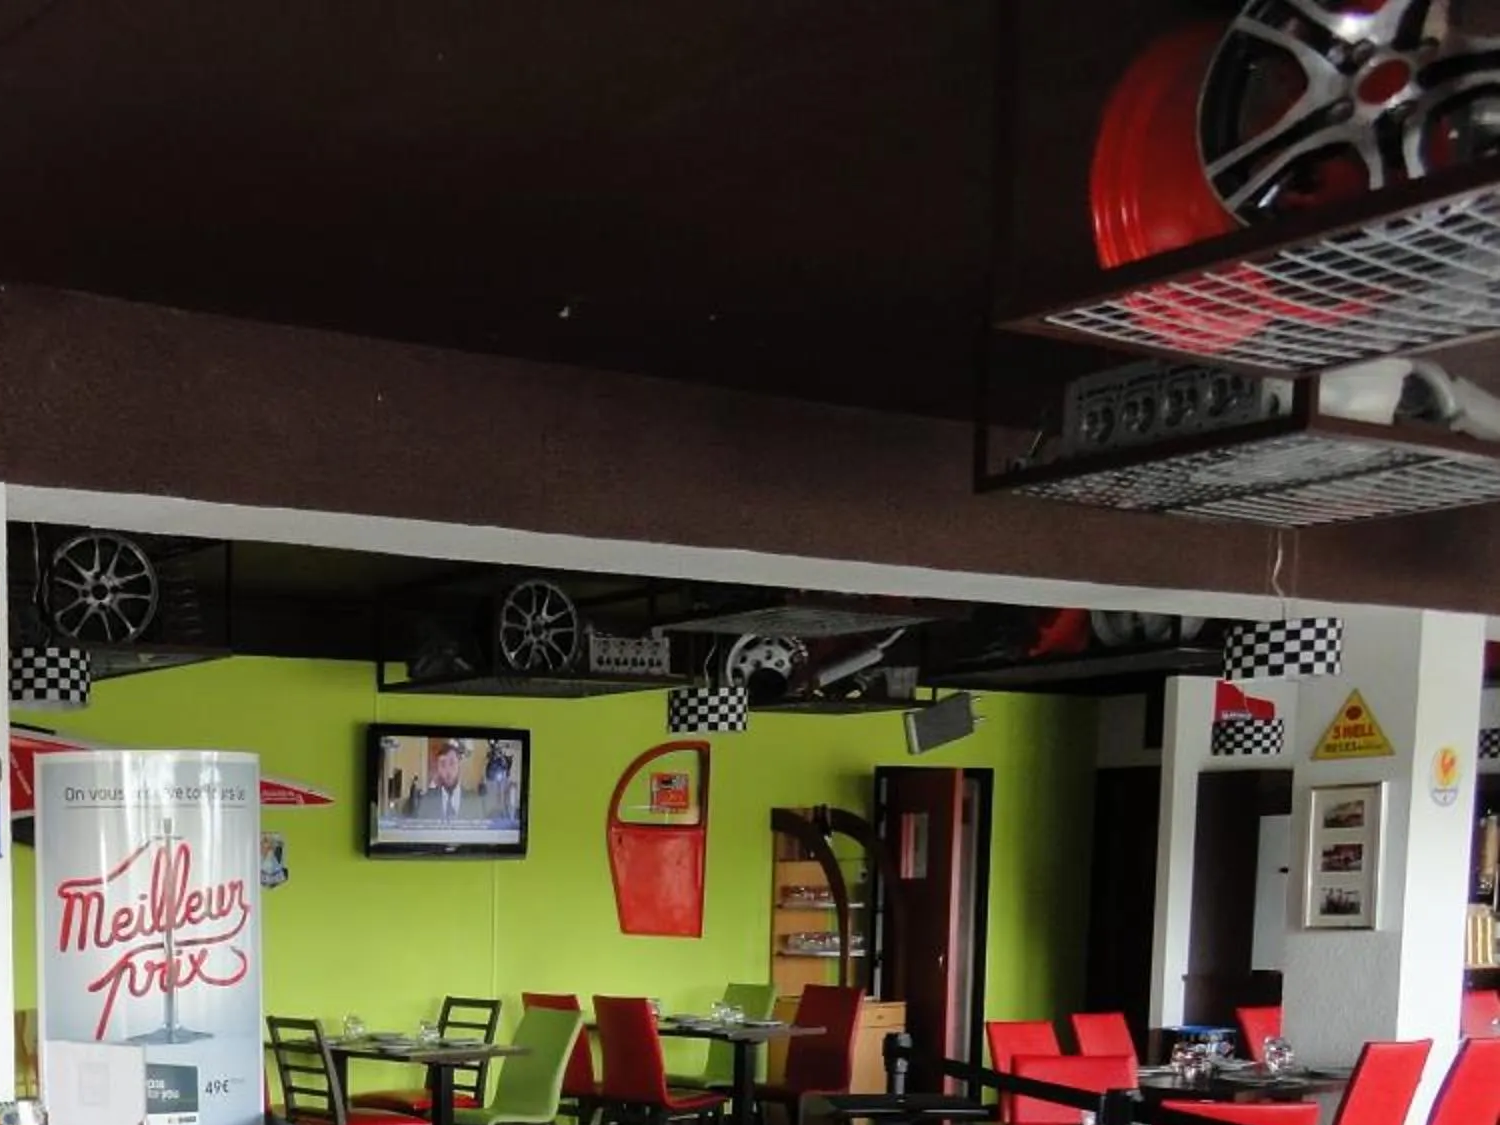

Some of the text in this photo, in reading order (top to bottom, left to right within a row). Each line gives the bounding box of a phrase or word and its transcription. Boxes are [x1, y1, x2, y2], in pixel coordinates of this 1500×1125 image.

[58, 841, 250, 952] Meilleur
[88, 945, 238, 1040] prix
[205, 1079, 230, 1095] 49€
